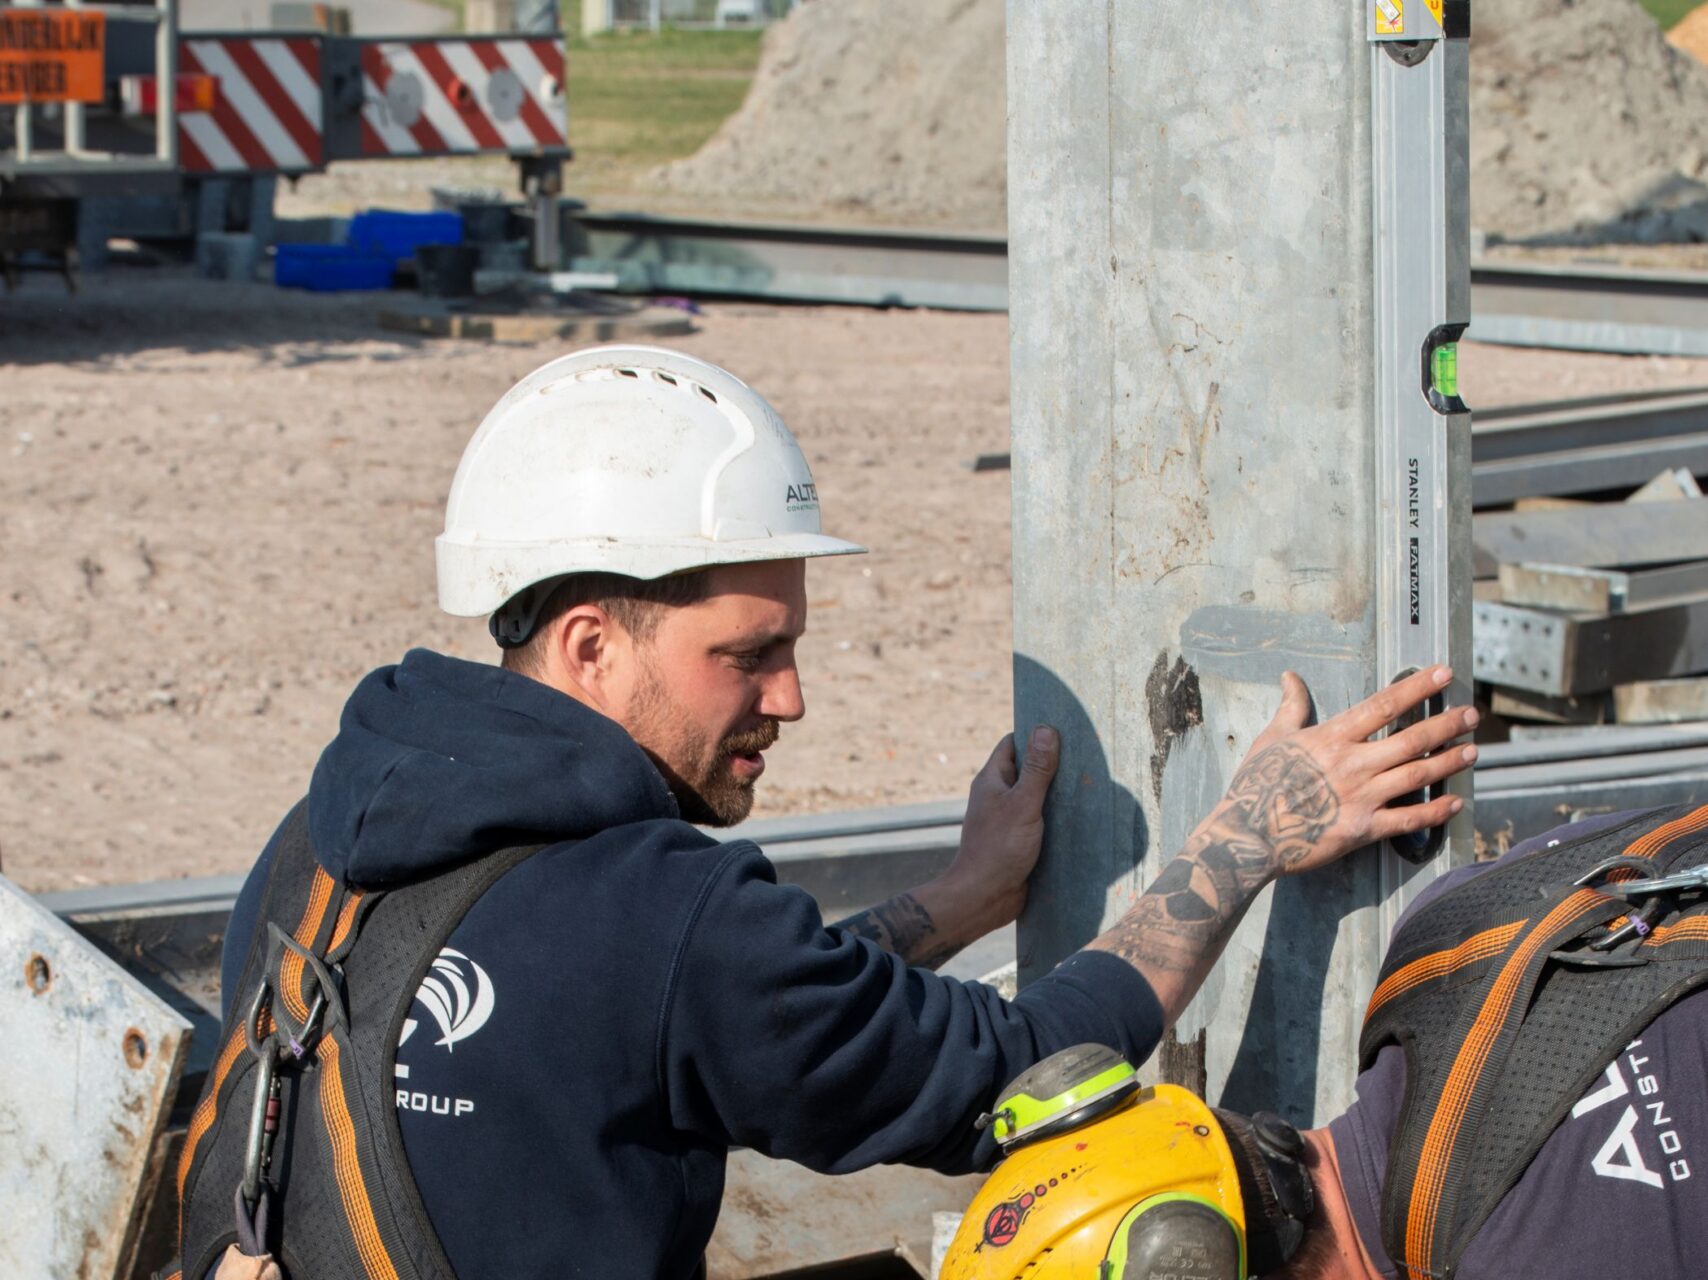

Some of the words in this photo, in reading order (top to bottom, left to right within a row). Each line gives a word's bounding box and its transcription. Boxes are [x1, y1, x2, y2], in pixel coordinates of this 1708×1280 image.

[1408, 457, 1419, 529] STANLEY
[1409, 544, 1420, 617] FATMAX
[395, 1089, 475, 1117] ROUP
